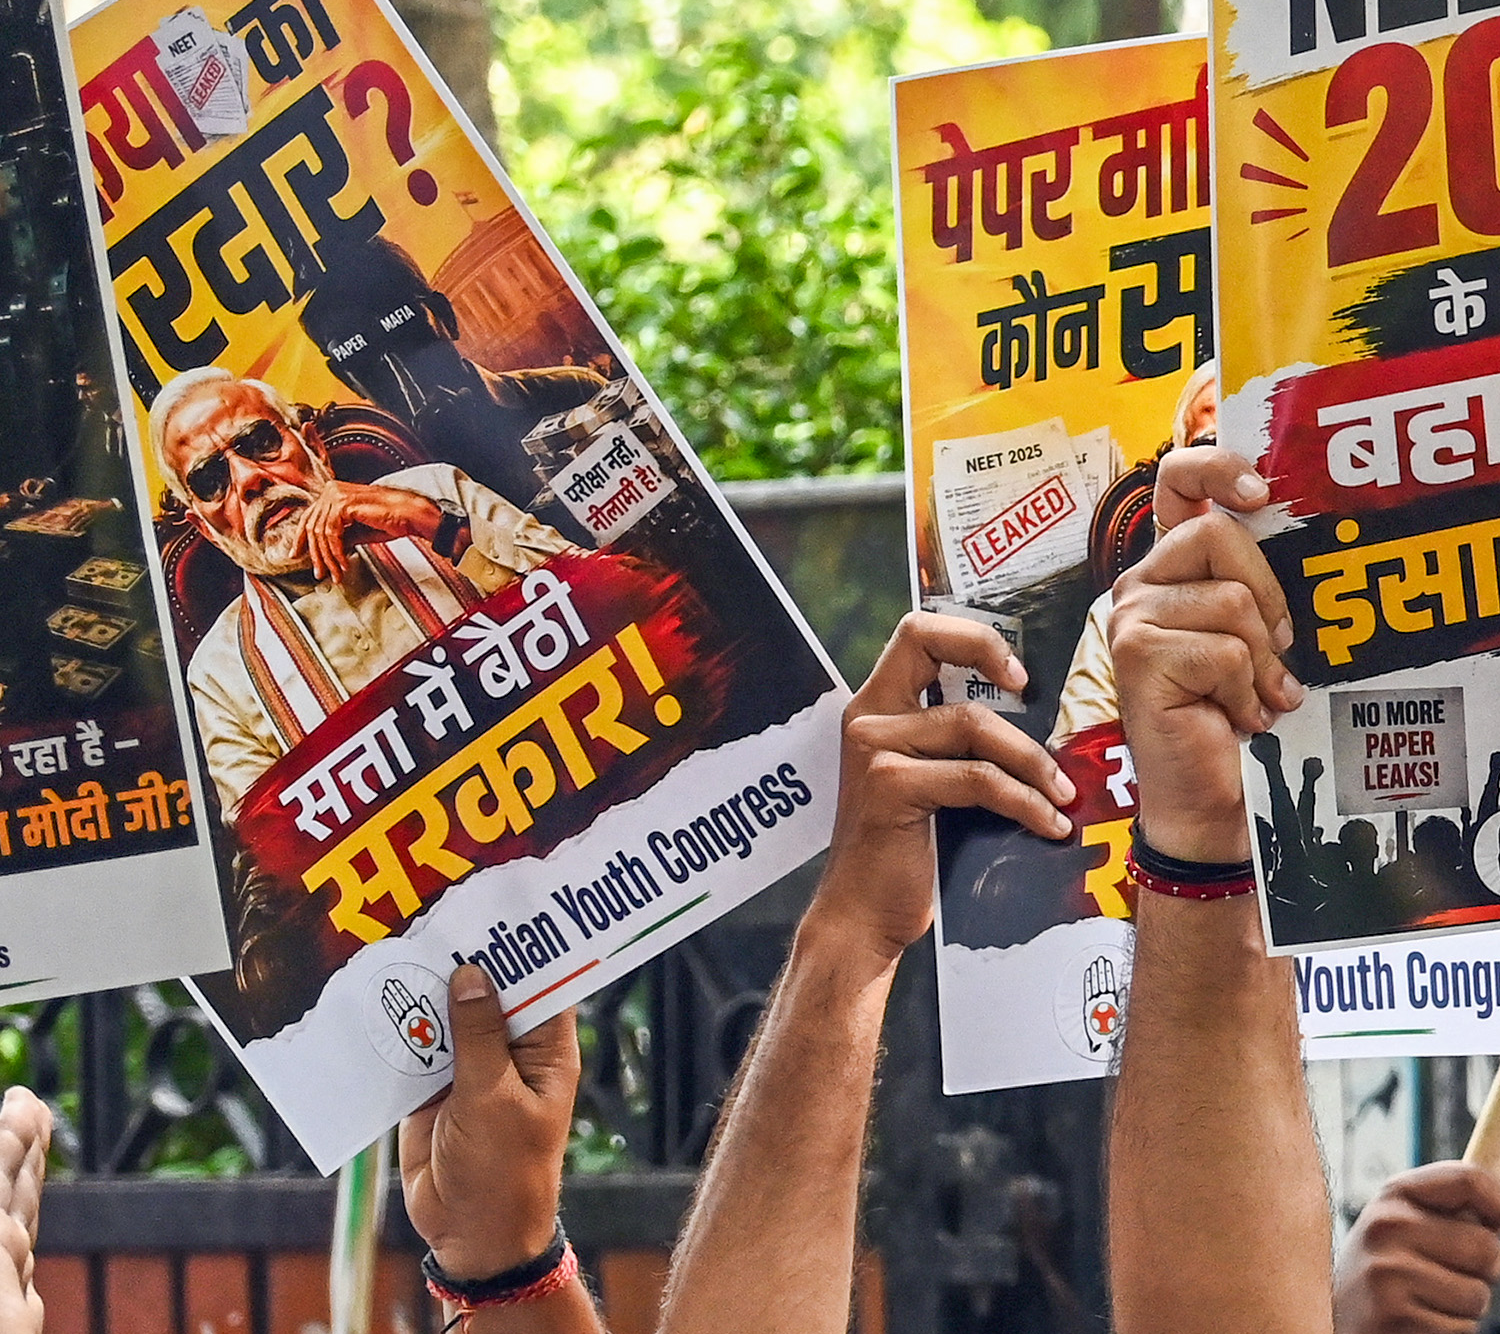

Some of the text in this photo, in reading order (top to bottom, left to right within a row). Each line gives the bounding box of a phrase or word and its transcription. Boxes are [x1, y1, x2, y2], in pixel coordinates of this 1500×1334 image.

[167, 30, 198, 58] NEET
[190, 58, 222, 109] LEAKED
[924, 122, 1080, 262] पेपर
[379, 304, 416, 334] MAFIA
[977, 270, 1105, 390] कौन
[1428, 270, 1488, 338] के
[331, 332, 369, 364] PAPER
[966, 444, 1044, 474] NEET 2025
[585, 478, 642, 531] नीलामी
[971, 486, 1065, 566] LEAKED
[277, 570, 591, 841] सत्ता में बैठी
[1352, 699, 1446, 729] NO MORE
[8, 720, 105, 777] रहा है
[1365, 731, 1435, 759] PAPER
[301, 622, 683, 945] सरकार!
[1364, 761, 1440, 791] LEAKS!
[17, 781, 109, 849] मोदी
[116, 770, 192, 833] जी?
[552, 763, 813, 936] Youth Congress
[1296, 952, 1395, 1014] Youth
